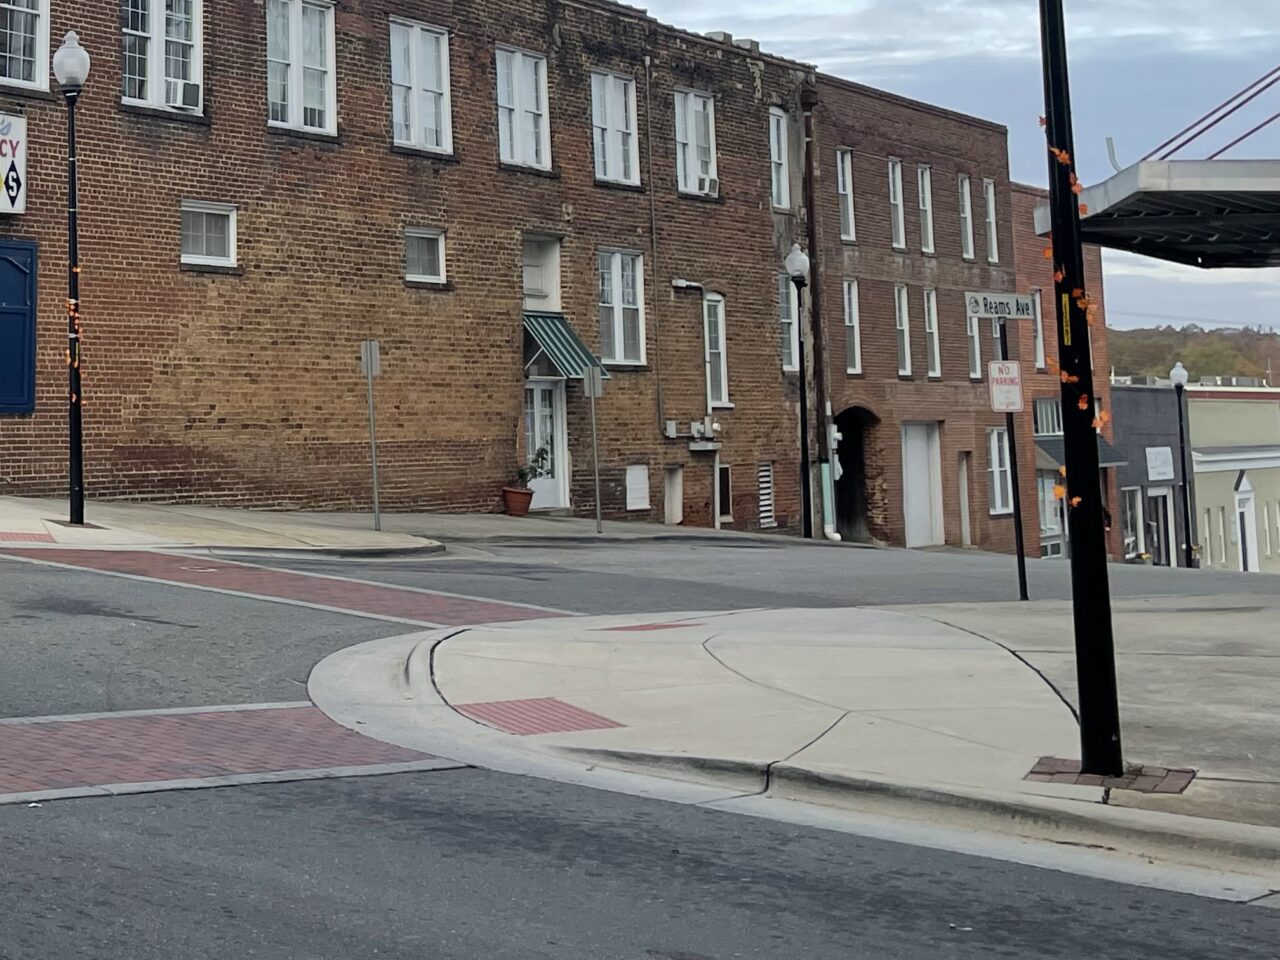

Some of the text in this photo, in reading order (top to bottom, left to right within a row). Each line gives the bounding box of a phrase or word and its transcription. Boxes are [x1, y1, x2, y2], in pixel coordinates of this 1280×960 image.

[983, 296, 1031, 316] Reams Ave
[998, 366, 1010, 376] NO
[992, 376, 1020, 386] PARKING
